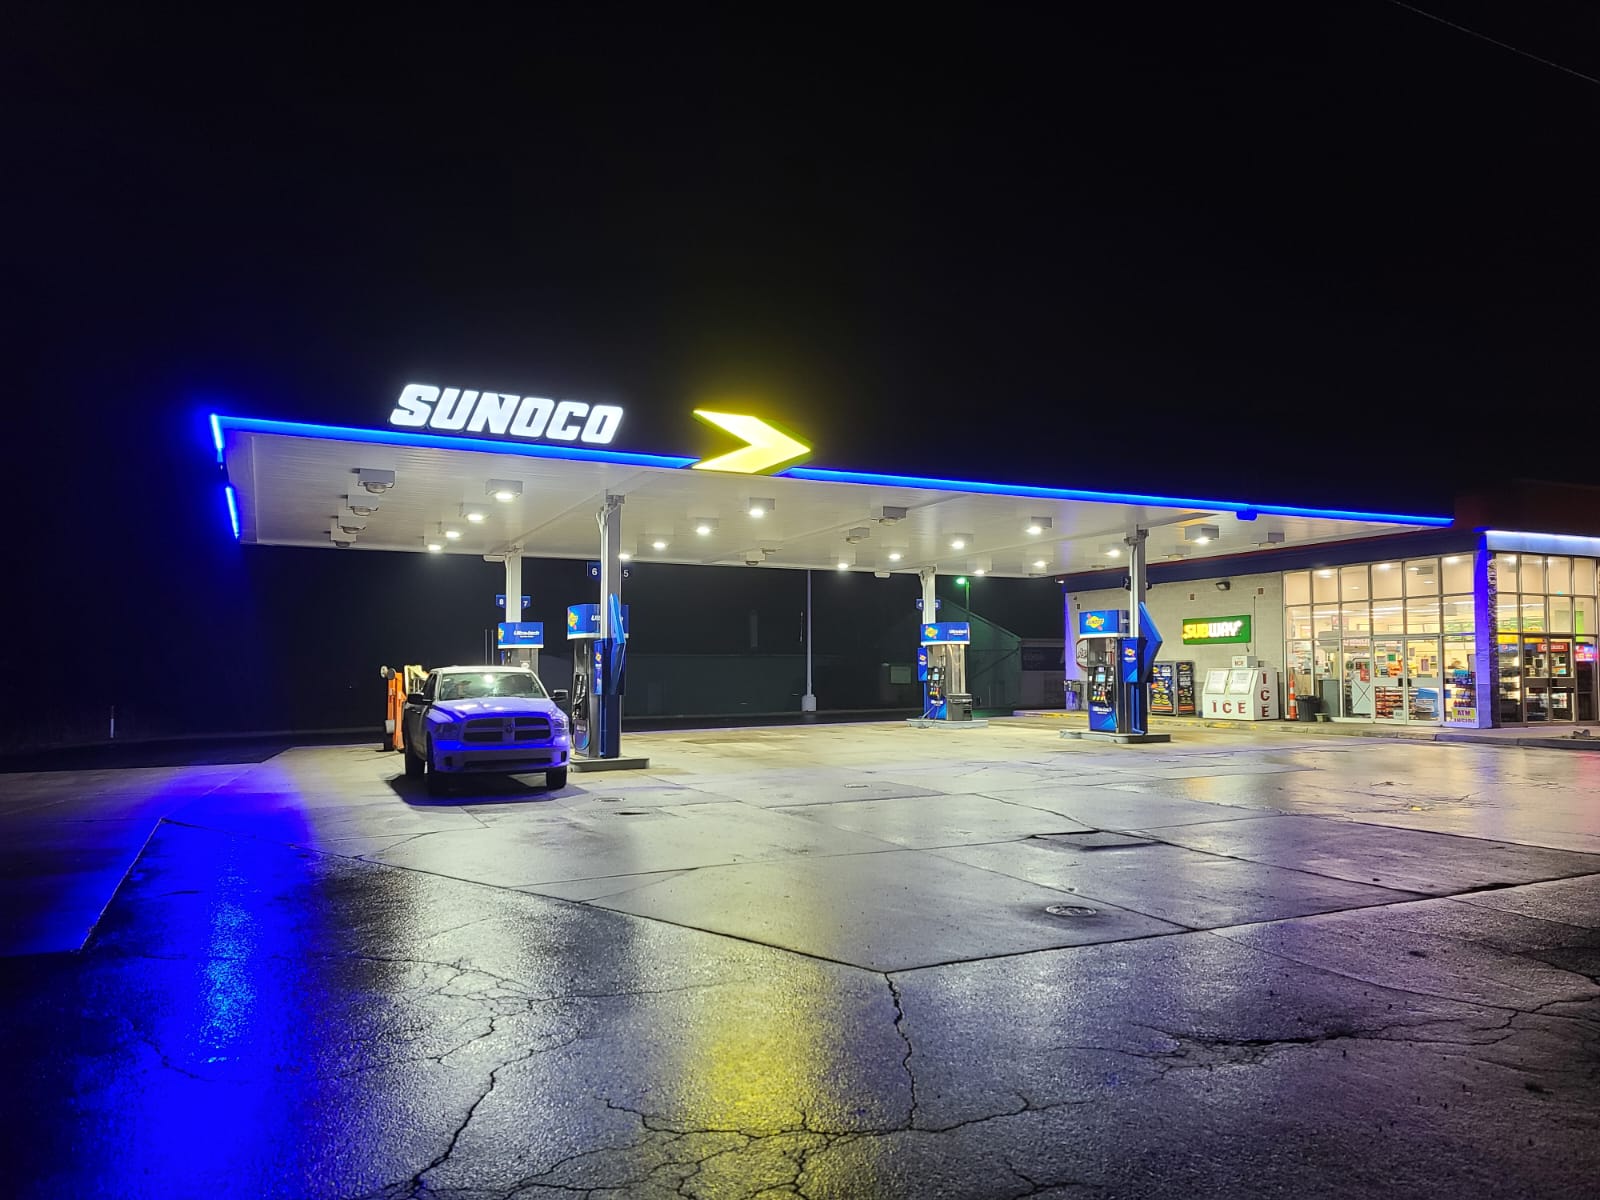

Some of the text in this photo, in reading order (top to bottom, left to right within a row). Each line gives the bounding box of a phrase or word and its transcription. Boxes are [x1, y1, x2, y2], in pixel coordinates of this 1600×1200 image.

[389, 383, 624, 445] SUNOCO
[591, 568, 598, 576] 6
[623, 569, 629, 578] 5
[1182, 620, 1243, 639] SUBWAY
[1260, 671, 1270, 718] ICE
[1211, 701, 1247, 714] ICE
